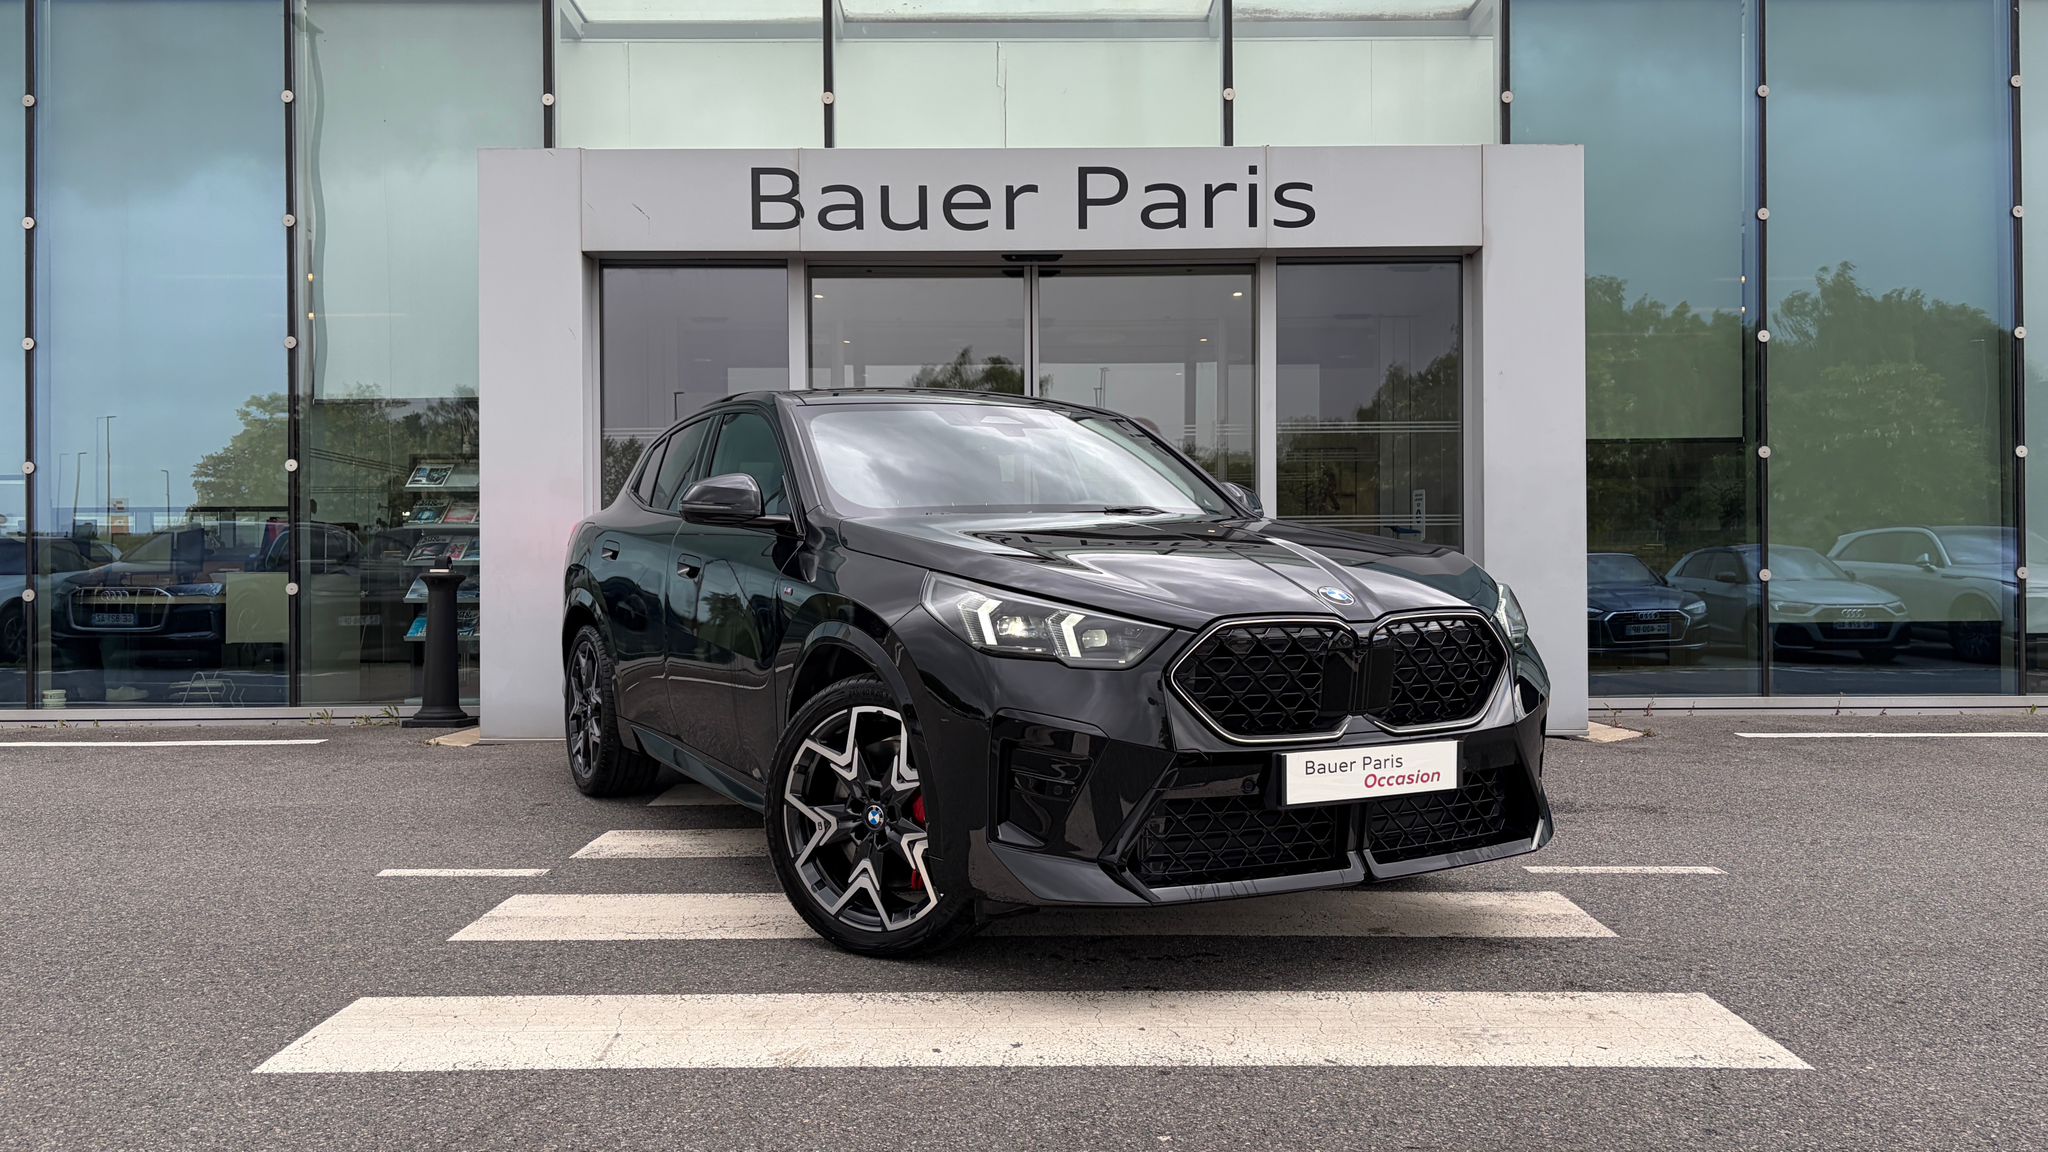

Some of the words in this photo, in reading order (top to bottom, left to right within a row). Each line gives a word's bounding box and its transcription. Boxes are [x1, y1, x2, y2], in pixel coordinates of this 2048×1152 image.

[751, 167, 1038, 232] Bauer
[1078, 165, 1316, 230] Paris
[1305, 760, 1356, 775] Bauer
[1362, 754, 1403, 771] Paris
[1364, 769, 1441, 789] Occasion
